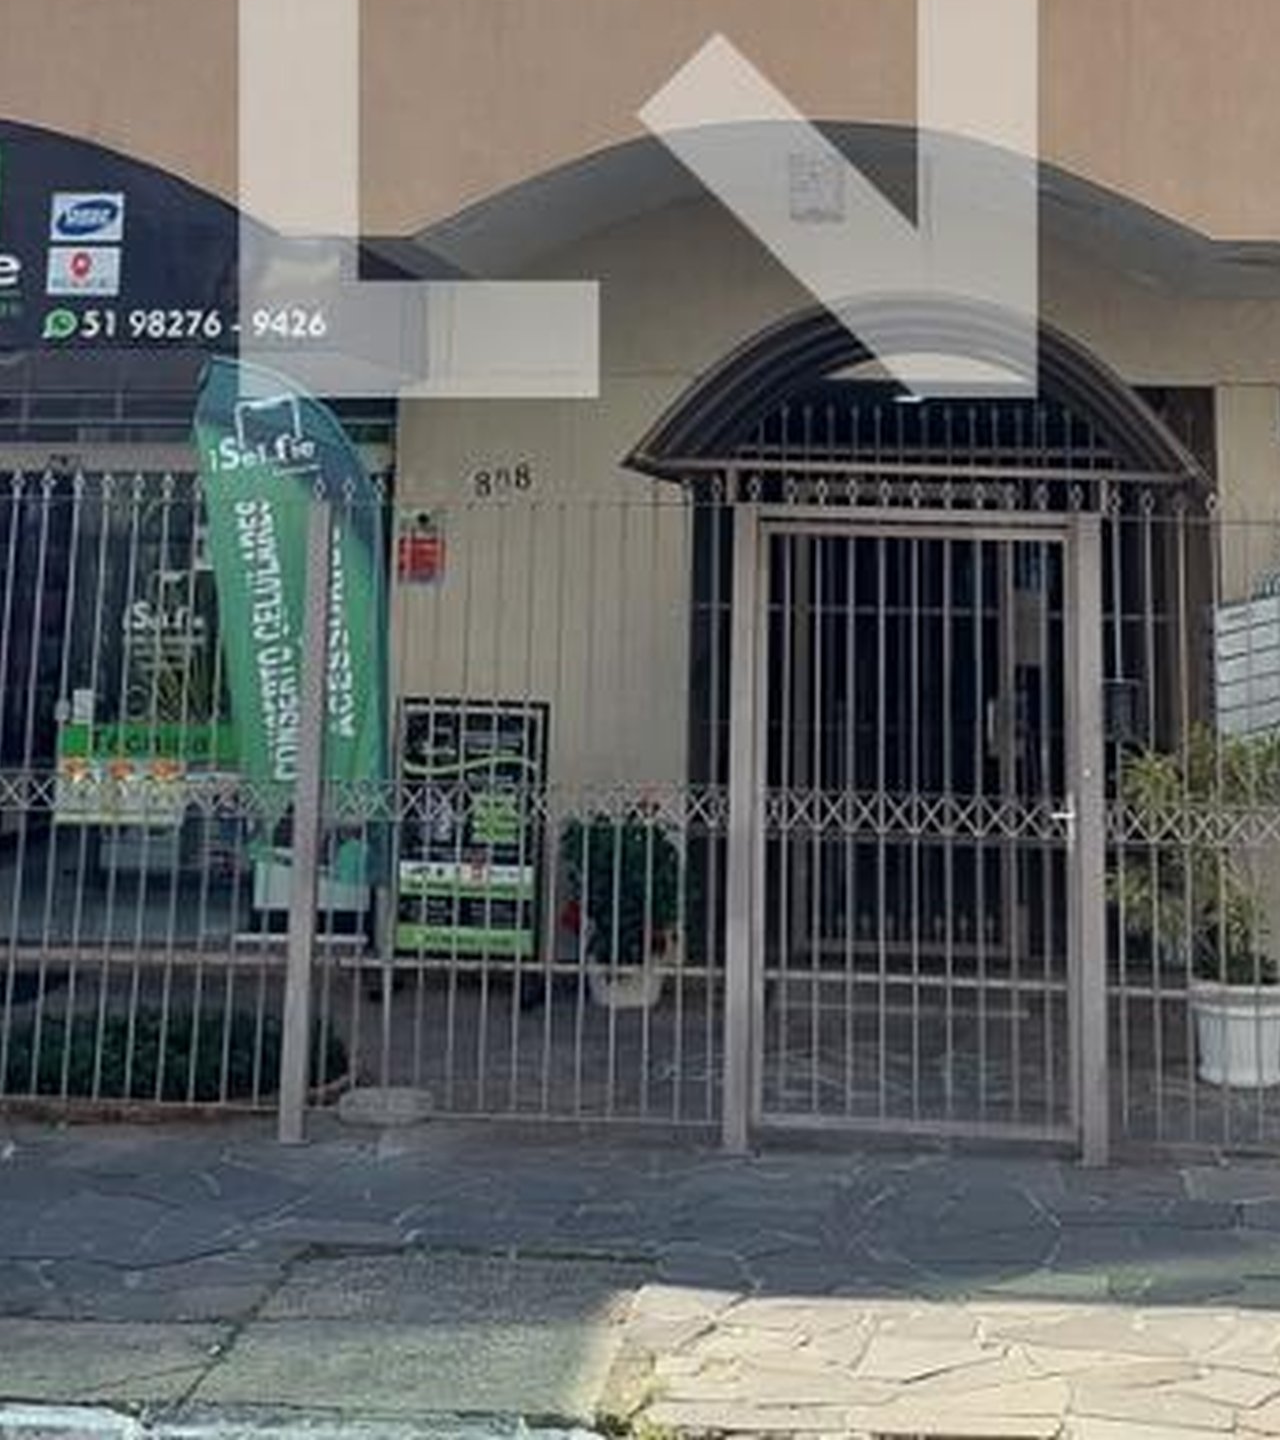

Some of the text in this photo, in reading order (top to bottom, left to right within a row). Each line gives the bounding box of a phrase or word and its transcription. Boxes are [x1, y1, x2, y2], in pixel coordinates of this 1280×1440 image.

[80, 310, 116, 337] 51
[129, 311, 222, 337] 98276
[252, 309, 328, 337] 9426
